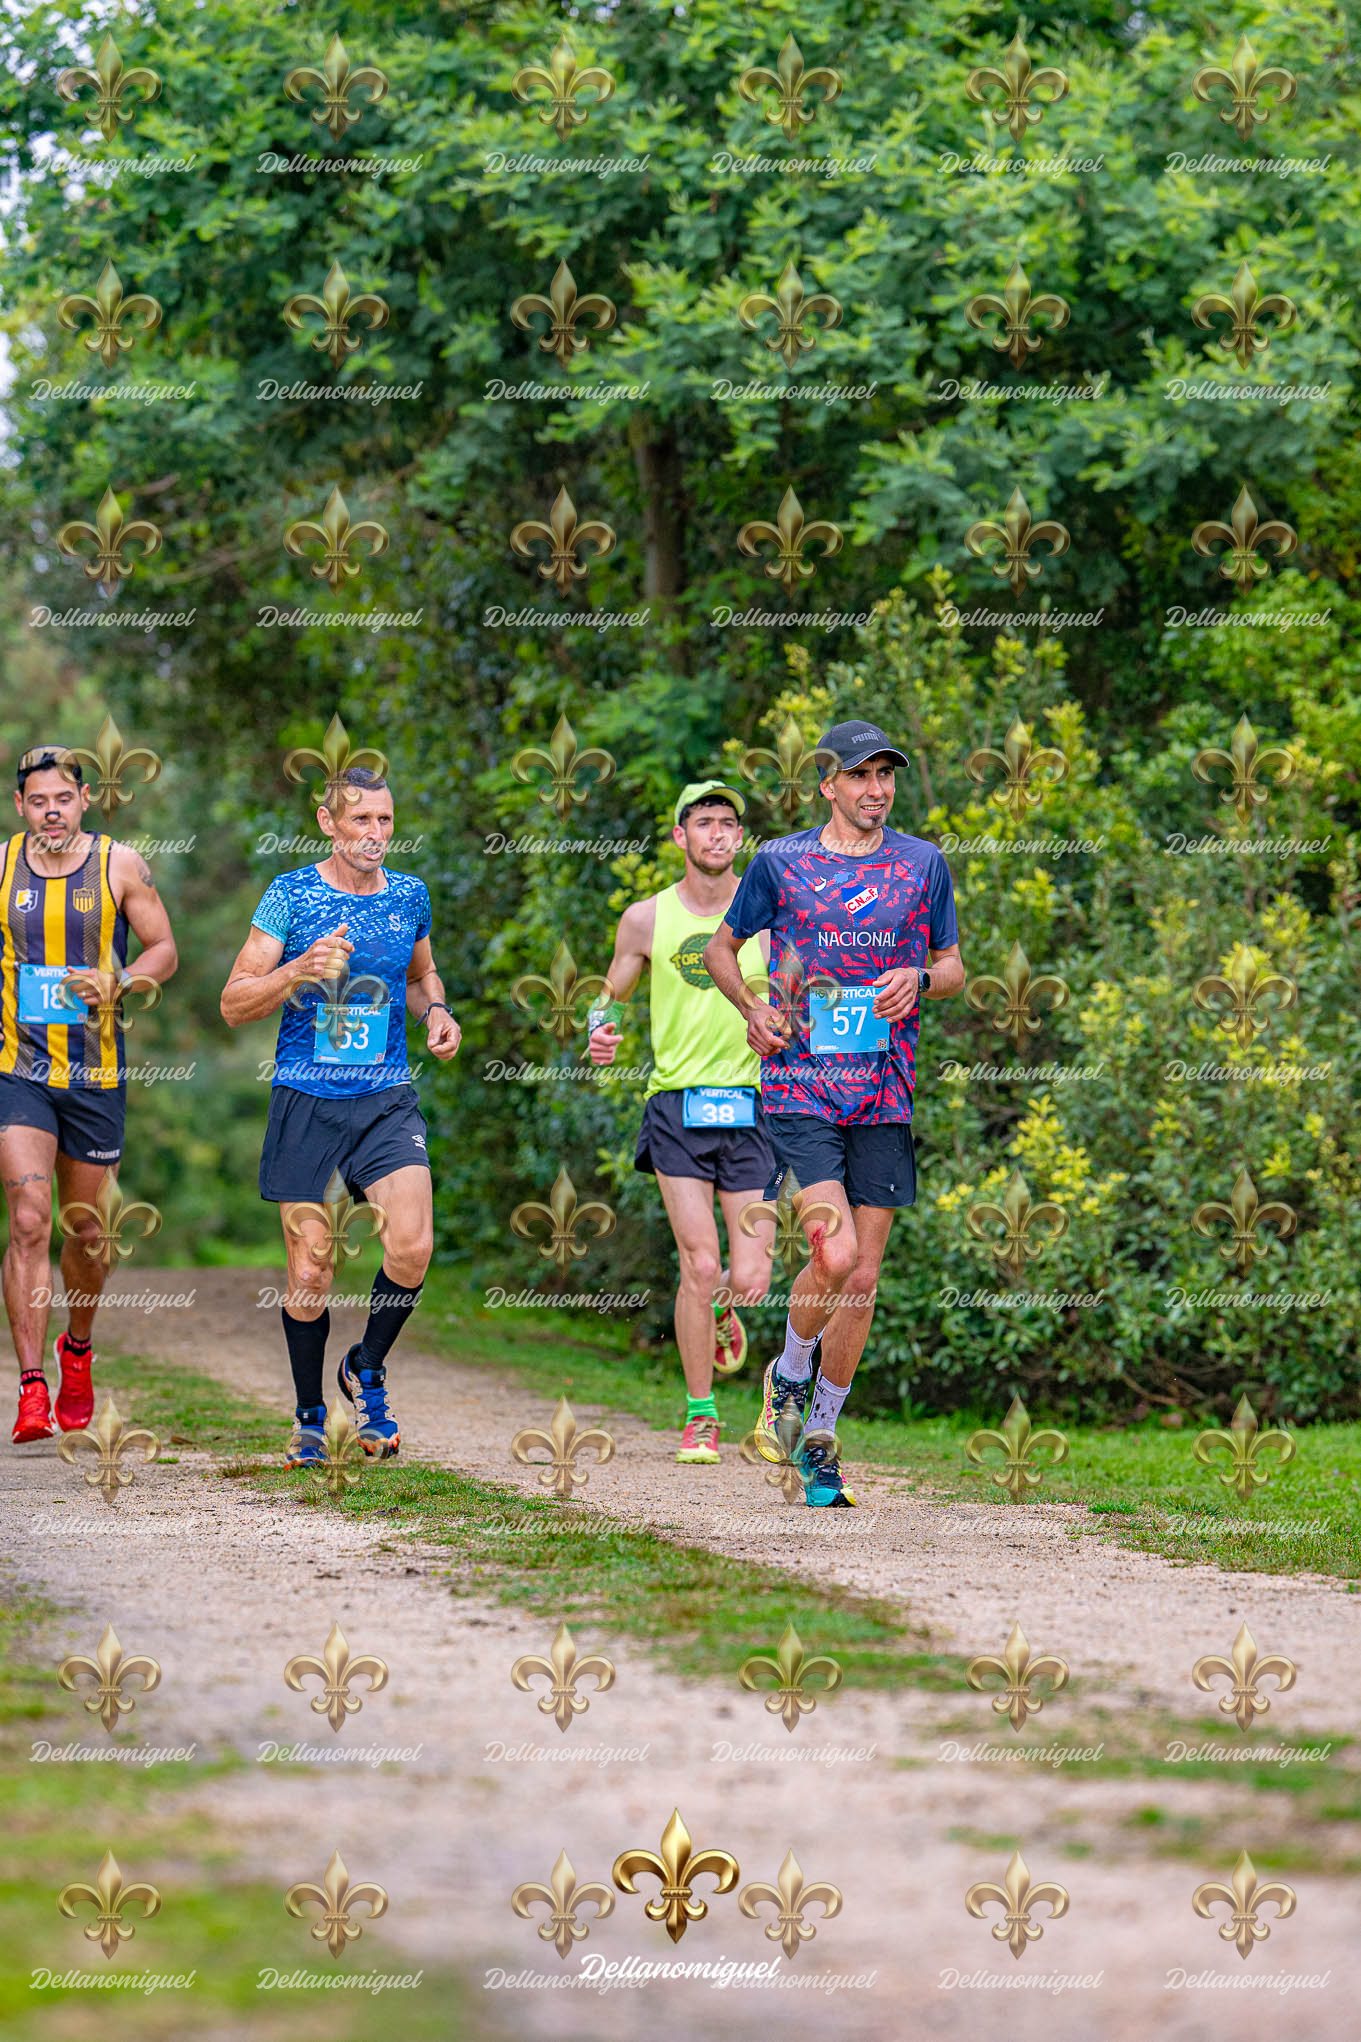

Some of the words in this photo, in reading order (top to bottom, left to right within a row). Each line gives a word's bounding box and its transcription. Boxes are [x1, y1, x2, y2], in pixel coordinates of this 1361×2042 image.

[851, 732, 881, 744] PUMA
[818, 931, 897, 947] NACIONAL
[32, 967, 70, 978] VERTIC
[40, 983, 65, 1010] 18
[827, 988, 878, 999] VERTICAL
[335, 1006, 381, 1016] VERTICAL
[832, 1005, 868, 1036] 57
[336, 1022, 370, 1050] 53
[699, 1087, 745, 1099] VERTICAL
[701, 1102, 736, 1124] 38
